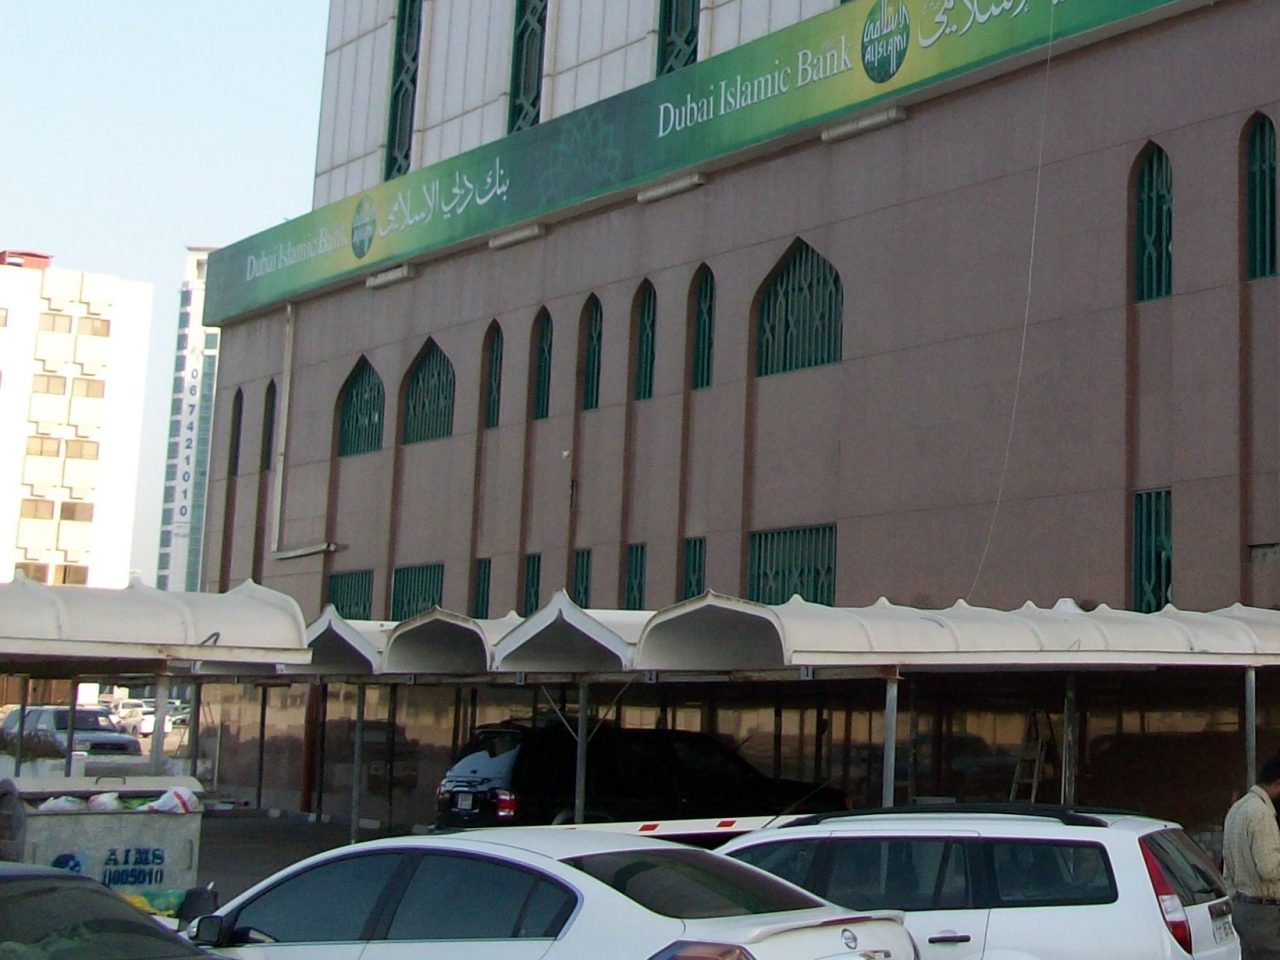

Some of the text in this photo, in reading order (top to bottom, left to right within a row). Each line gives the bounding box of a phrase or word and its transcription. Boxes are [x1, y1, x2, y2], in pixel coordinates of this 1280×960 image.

[657, 34, 853, 140] Dubai Islamic Bank
[475, 156, 511, 205] بنك
